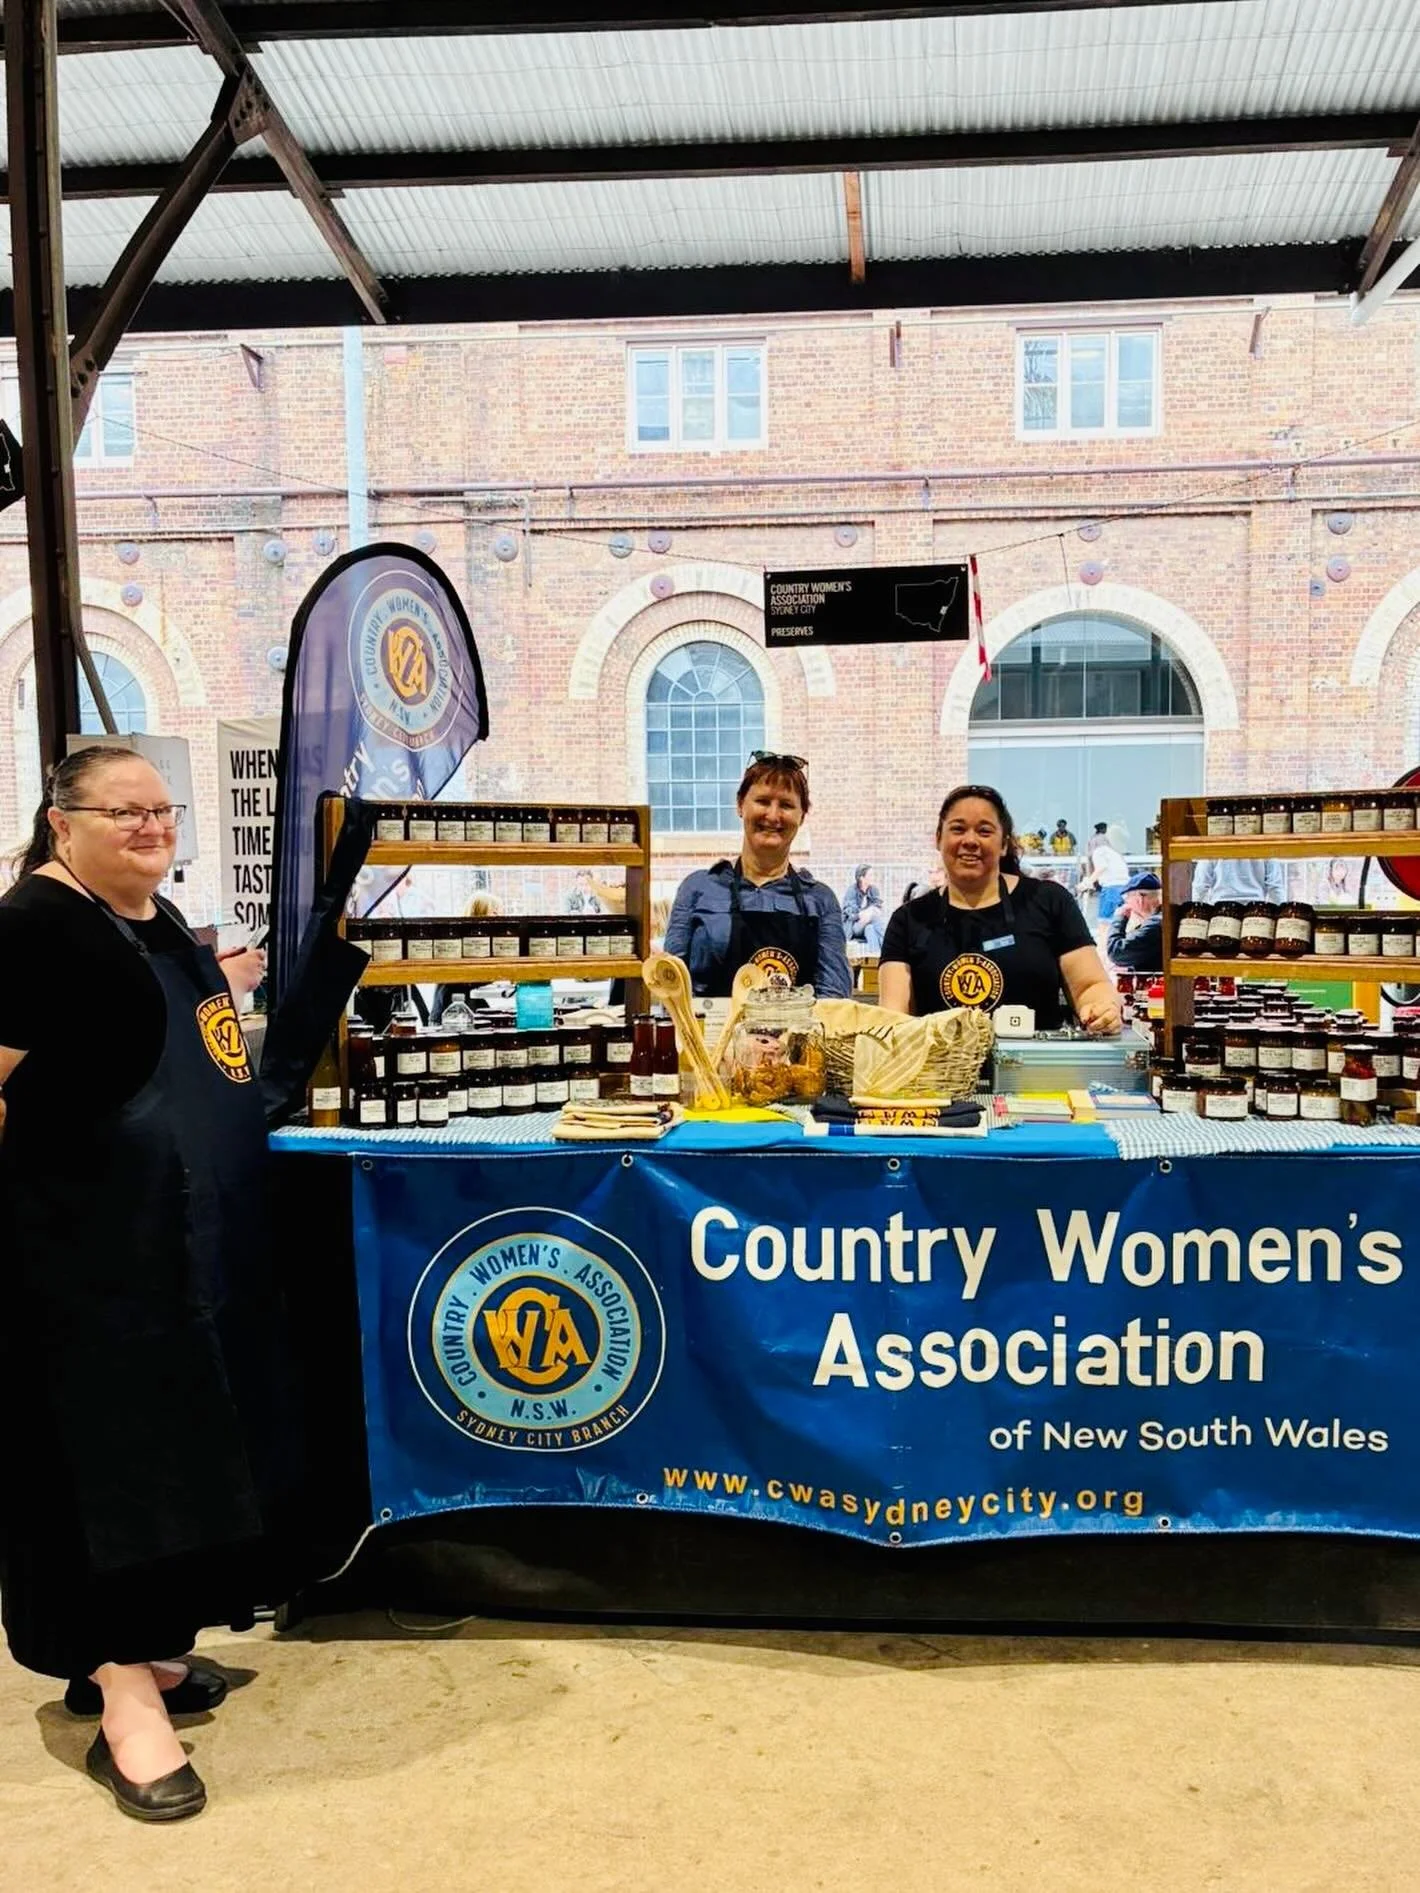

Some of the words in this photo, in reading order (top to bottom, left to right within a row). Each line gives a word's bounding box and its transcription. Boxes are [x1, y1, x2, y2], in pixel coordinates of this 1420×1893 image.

[770, 583, 809, 594] COUNTRY
[810, 581, 852, 592] WOMEN'S
[770, 593, 825, 606] ASSOCIATION
[771, 605, 799, 615] SYDNEY
[800, 604, 816, 614] CITY
[771, 626, 814, 637] PRESERVES
[230, 749, 279, 780] WHEN
[231, 787, 262, 817] THE
[266, 787, 276, 817] L
[232, 826, 272, 856] TIME
[233, 863, 273, 894] TAST
[234, 900, 271, 931] SOM
[199, 996, 230, 1022] WOMEN
[690, 1206, 997, 1299] Country
[1036, 1208, 1403, 1287] Women's
[442, 1295, 477, 1387] COUNTRY
[469, 1244, 561, 1285] WOMEN'S
[574, 1263, 631, 1382] ASSOCIATION
[812, 1313, 1265, 1391] Association
[456, 1409, 518, 1444] SYDNEY
[527, 1432, 563, 1446] CITY
[571, 1404, 630, 1443] BRANCH
[510, 1399, 577, 1420] N.S.W.
[989, 1419, 1031, 1450] of
[1043, 1421, 1126, 1450] New
[1138, 1416, 1252, 1451] South
[1263, 1416, 1390, 1453] Wales
[662, 1467, 1144, 1526] www.cwasydneycity.org
